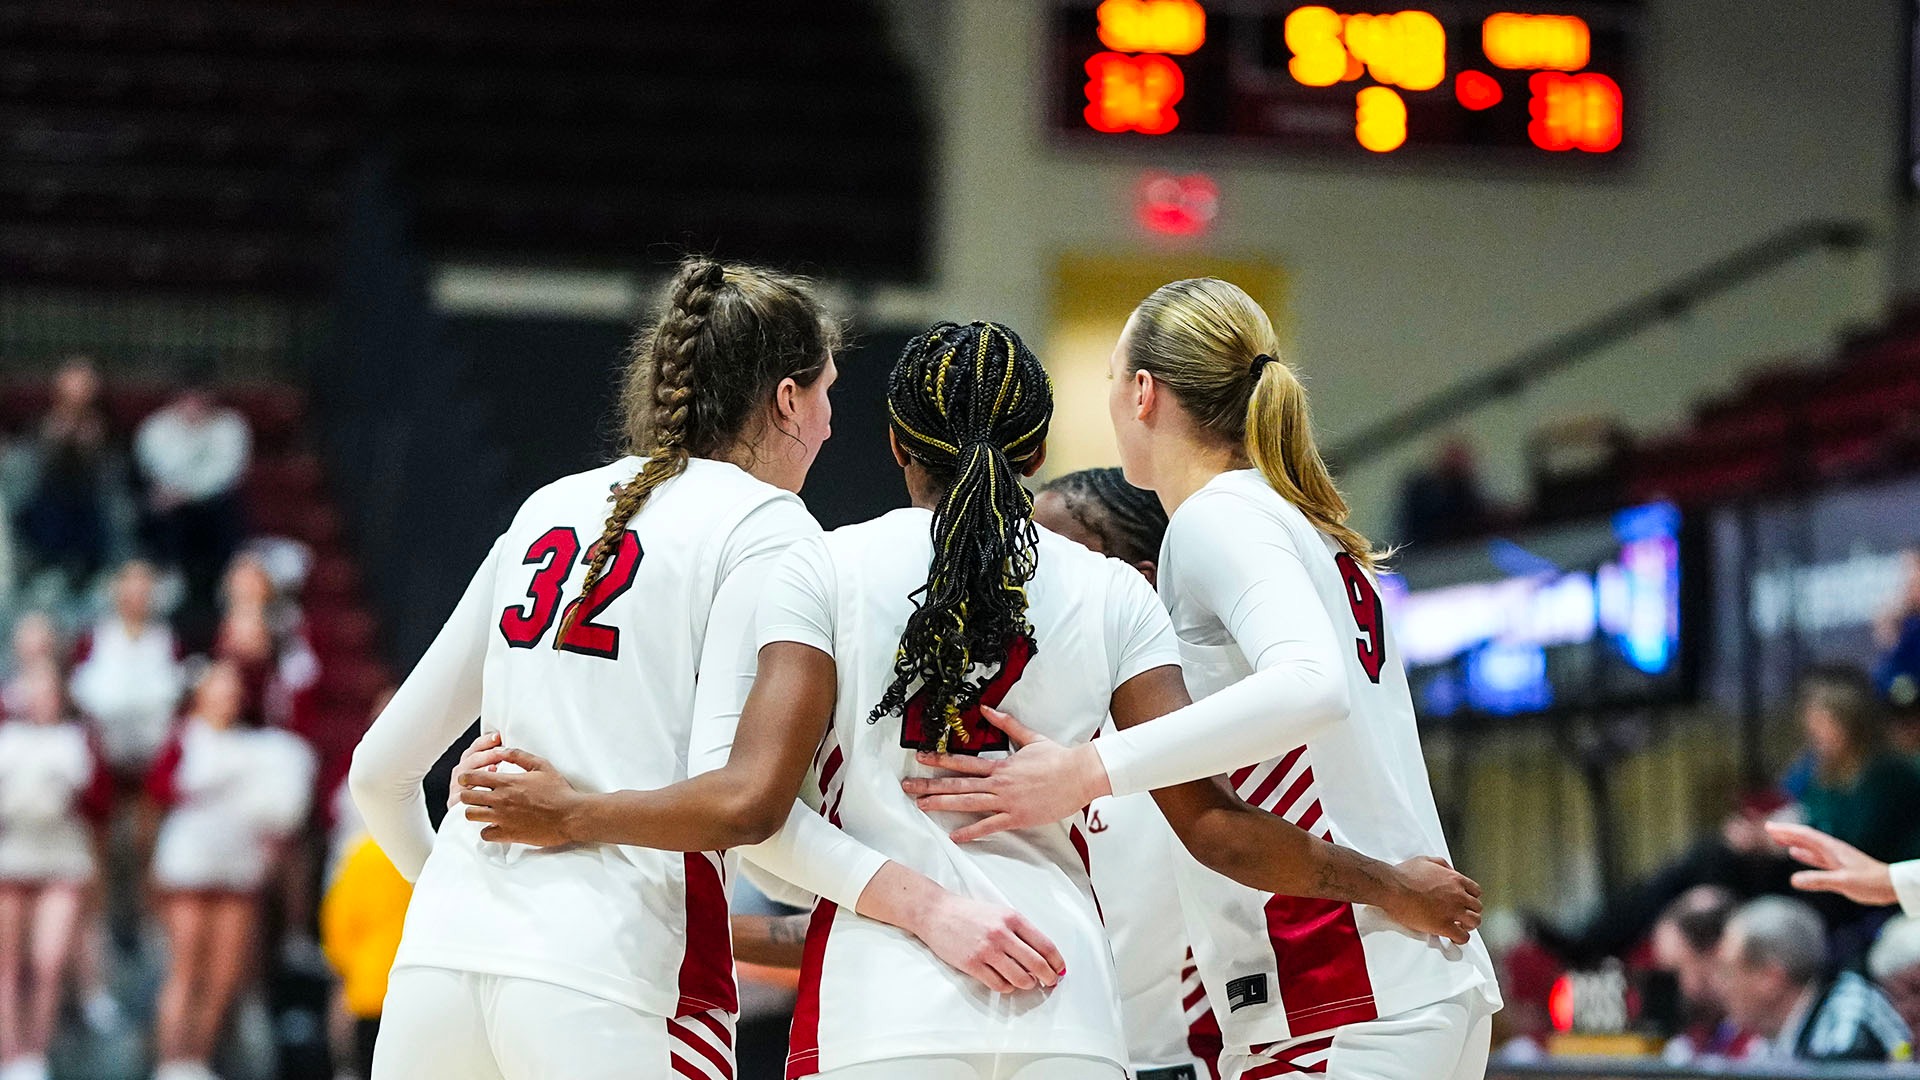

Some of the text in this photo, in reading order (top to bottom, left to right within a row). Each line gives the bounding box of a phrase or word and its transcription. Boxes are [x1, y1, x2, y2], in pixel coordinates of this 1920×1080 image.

[499, 526, 645, 660] 32
[1335, 552, 1386, 684] 9
[1250, 984, 1257, 996] L
